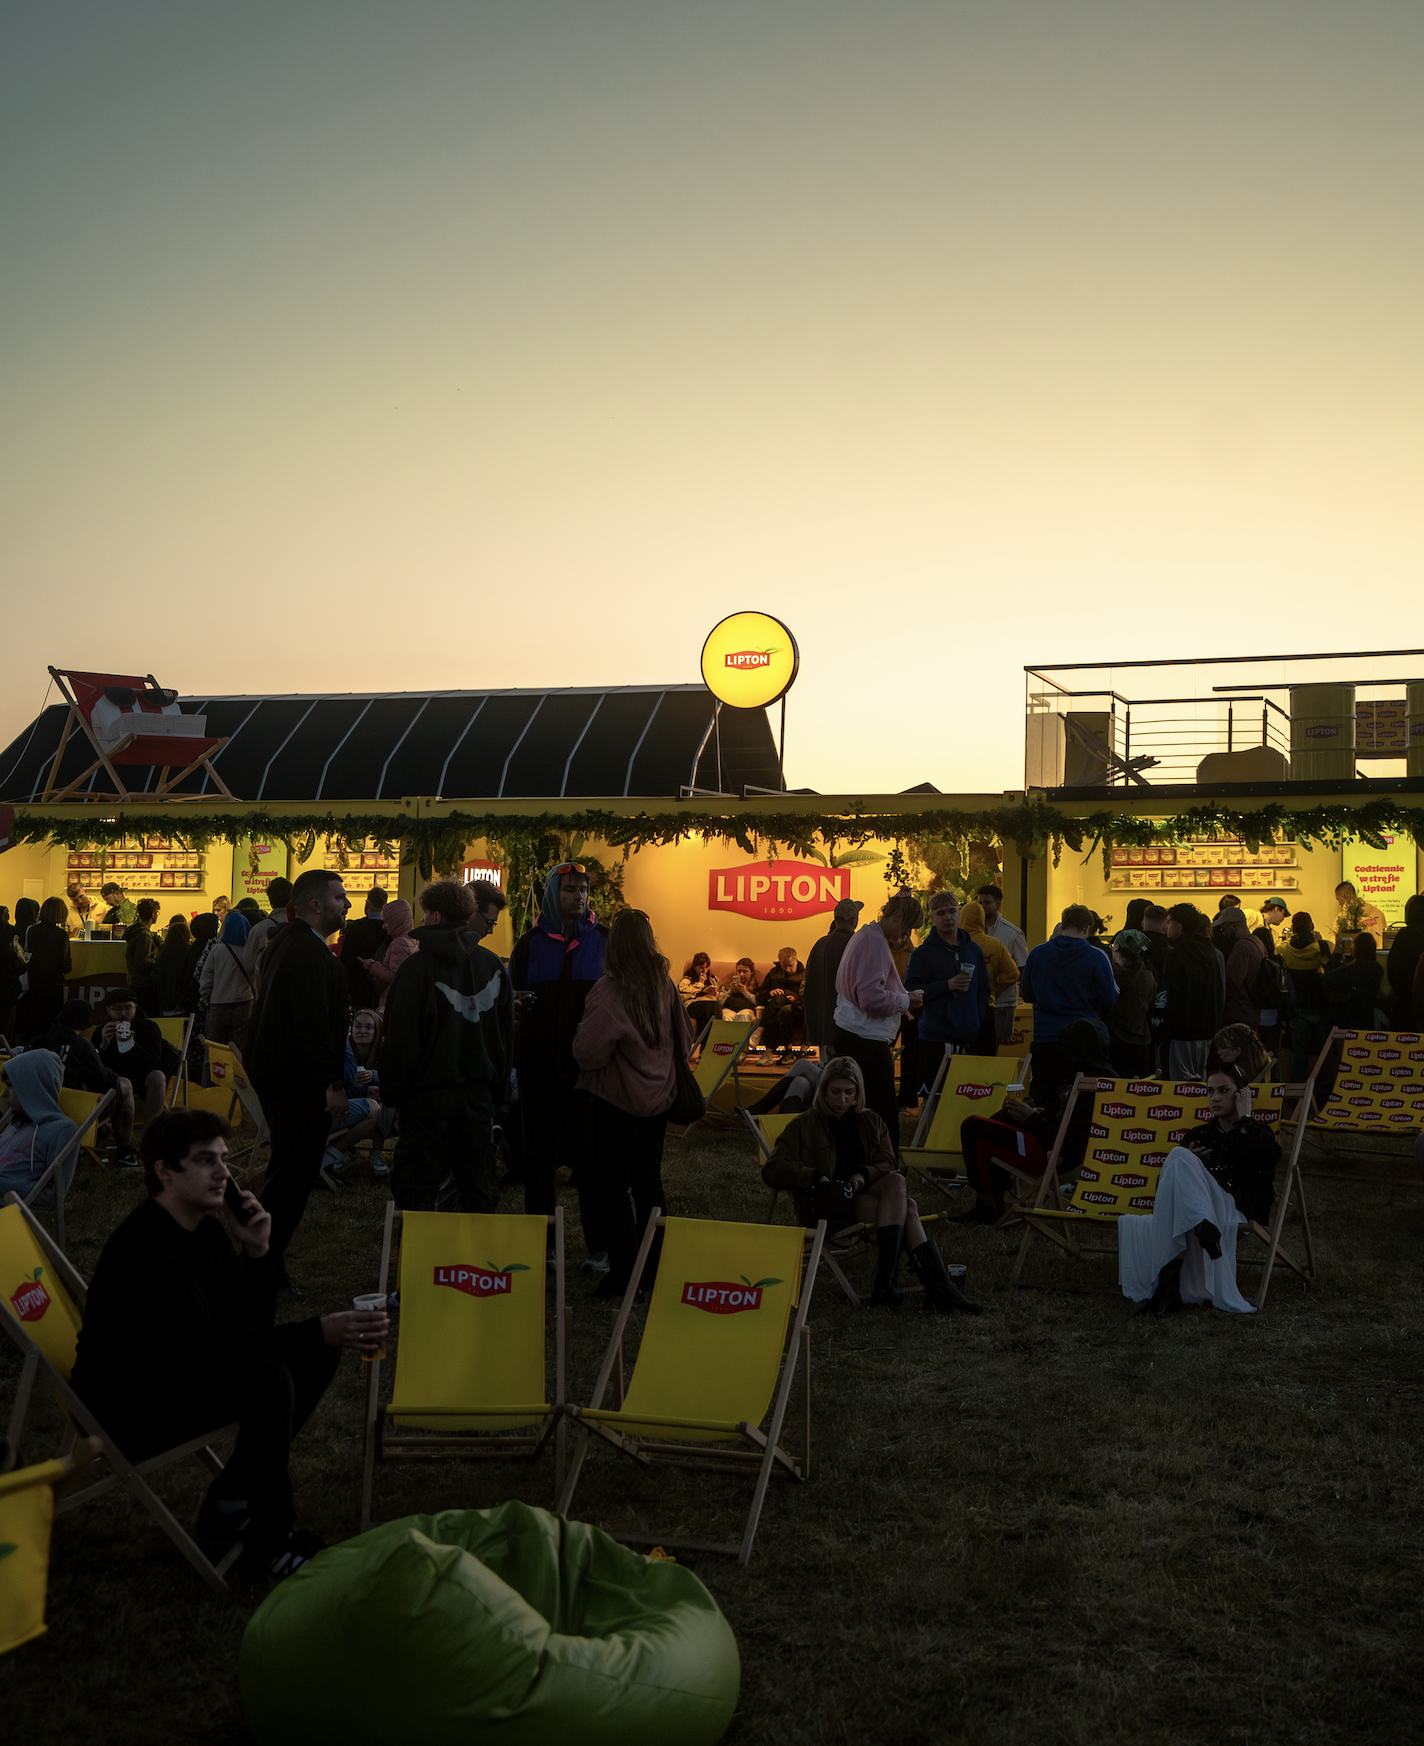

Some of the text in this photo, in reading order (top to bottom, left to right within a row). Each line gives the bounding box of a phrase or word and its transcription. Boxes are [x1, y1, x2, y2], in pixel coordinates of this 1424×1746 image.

[727, 655, 768, 665] LIPTON
[1307, 728, 1337, 736] LIPTON
[464, 868, 501, 887] LIPTON
[717, 876, 841, 902] LIPTON
[1363, 885, 1395, 893] Lipton!
[714, 1045, 734, 1053] LIPTON
[1349, 1049, 1369, 1057] Lipton
[1379, 1051, 1400, 1059] Lipton
[1360, 1067, 1381, 1075] Lipton
[1391, 1069, 1412, 1077] Lipton
[958, 1086, 992, 1096] LIPTON
[1129, 1083, 1159, 1095] Lipton
[1176, 1085, 1207, 1096] Lipton
[1341, 1081, 1362, 1089] Lipton
[1402, 1085, 1423, 1093] Lipton
[1350, 1098, 1372, 1106] Lipton
[1381, 1100, 1403, 1108] Lipton
[1104, 1105, 1133, 1117] Lipton
[1150, 1107, 1180, 1119] Lipton
[1328, 1109, 1350, 1117] Lipton
[1123, 1131, 1153, 1142] Lipton
[1095, 1151, 1166, 1166] Lipton Lipto
[1114, 1175, 1145, 1187] Lipton
[1084, 1192, 1154, 1208] Lipton Lipto
[439, 1269, 506, 1291] LIPTON
[14, 1285, 48, 1316] LIPTON
[687, 1286, 757, 1306] LIPTON
